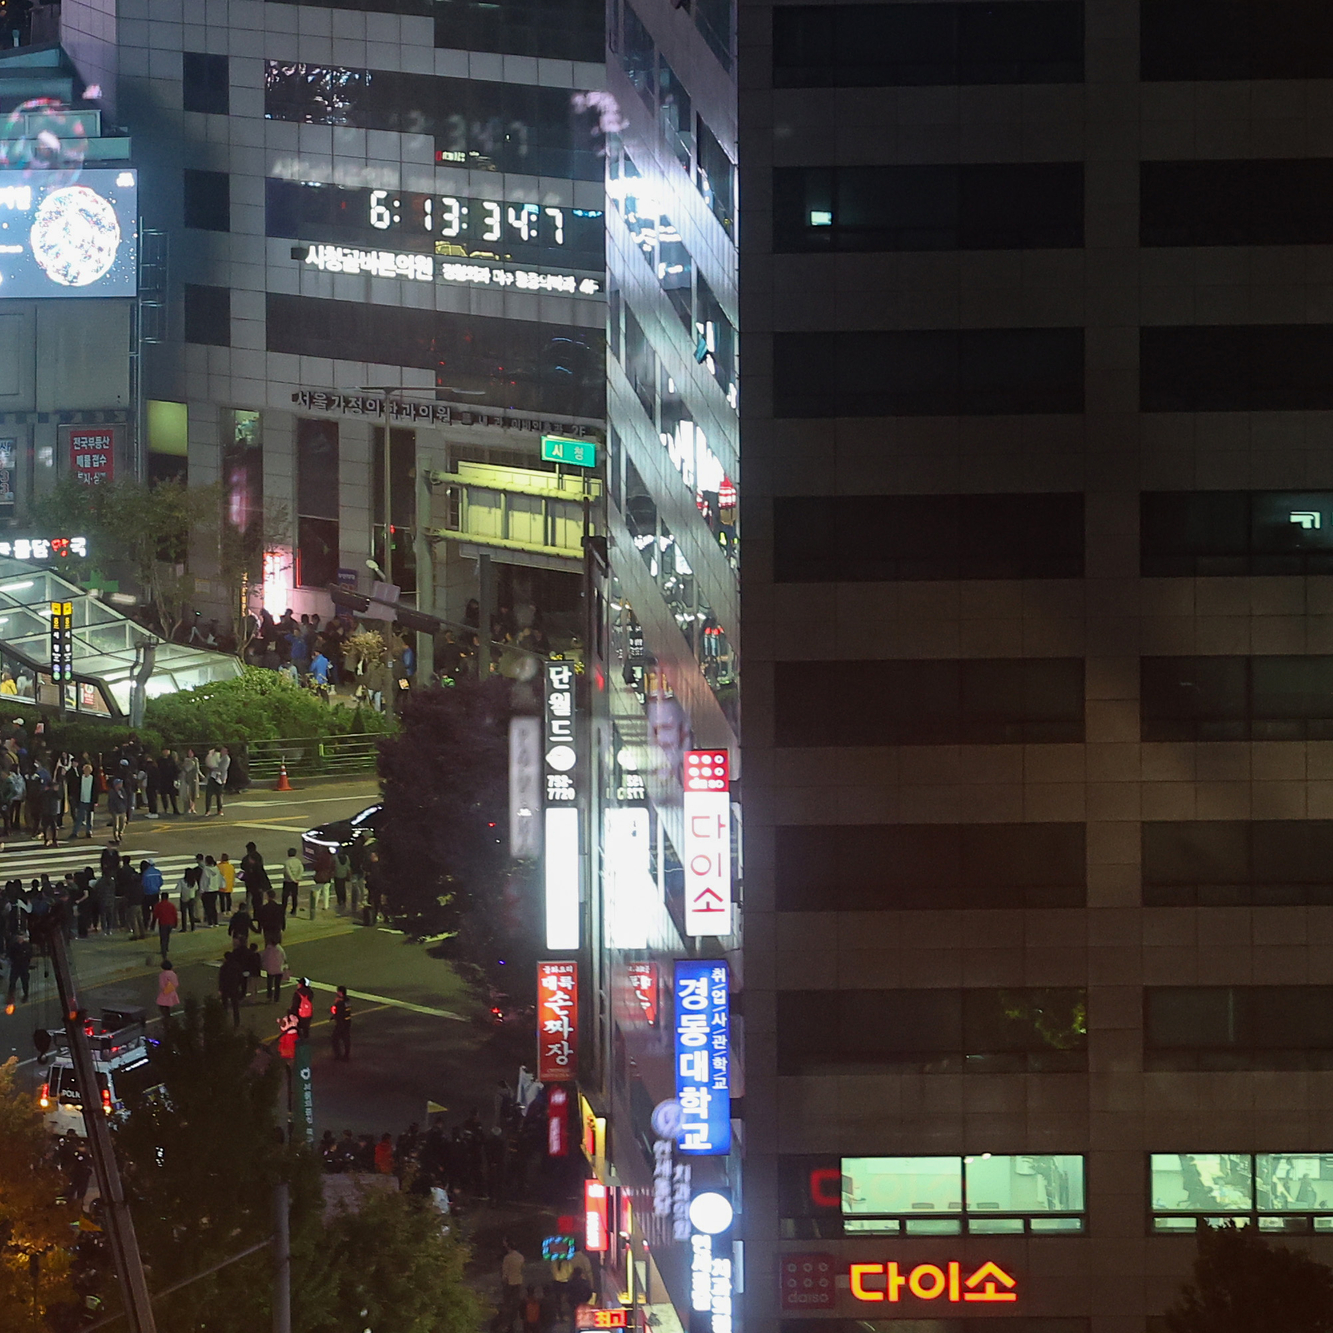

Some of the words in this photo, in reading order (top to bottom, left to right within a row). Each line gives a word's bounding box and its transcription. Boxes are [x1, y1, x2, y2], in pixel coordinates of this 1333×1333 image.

[548, 666, 573, 742] 단월드
[690, 814, 726, 913] 다이소
[544, 990, 574, 1066] 손짜장
[677, 976, 713, 1152] 경동대학교
[849, 1260, 1019, 1303] 다이소
